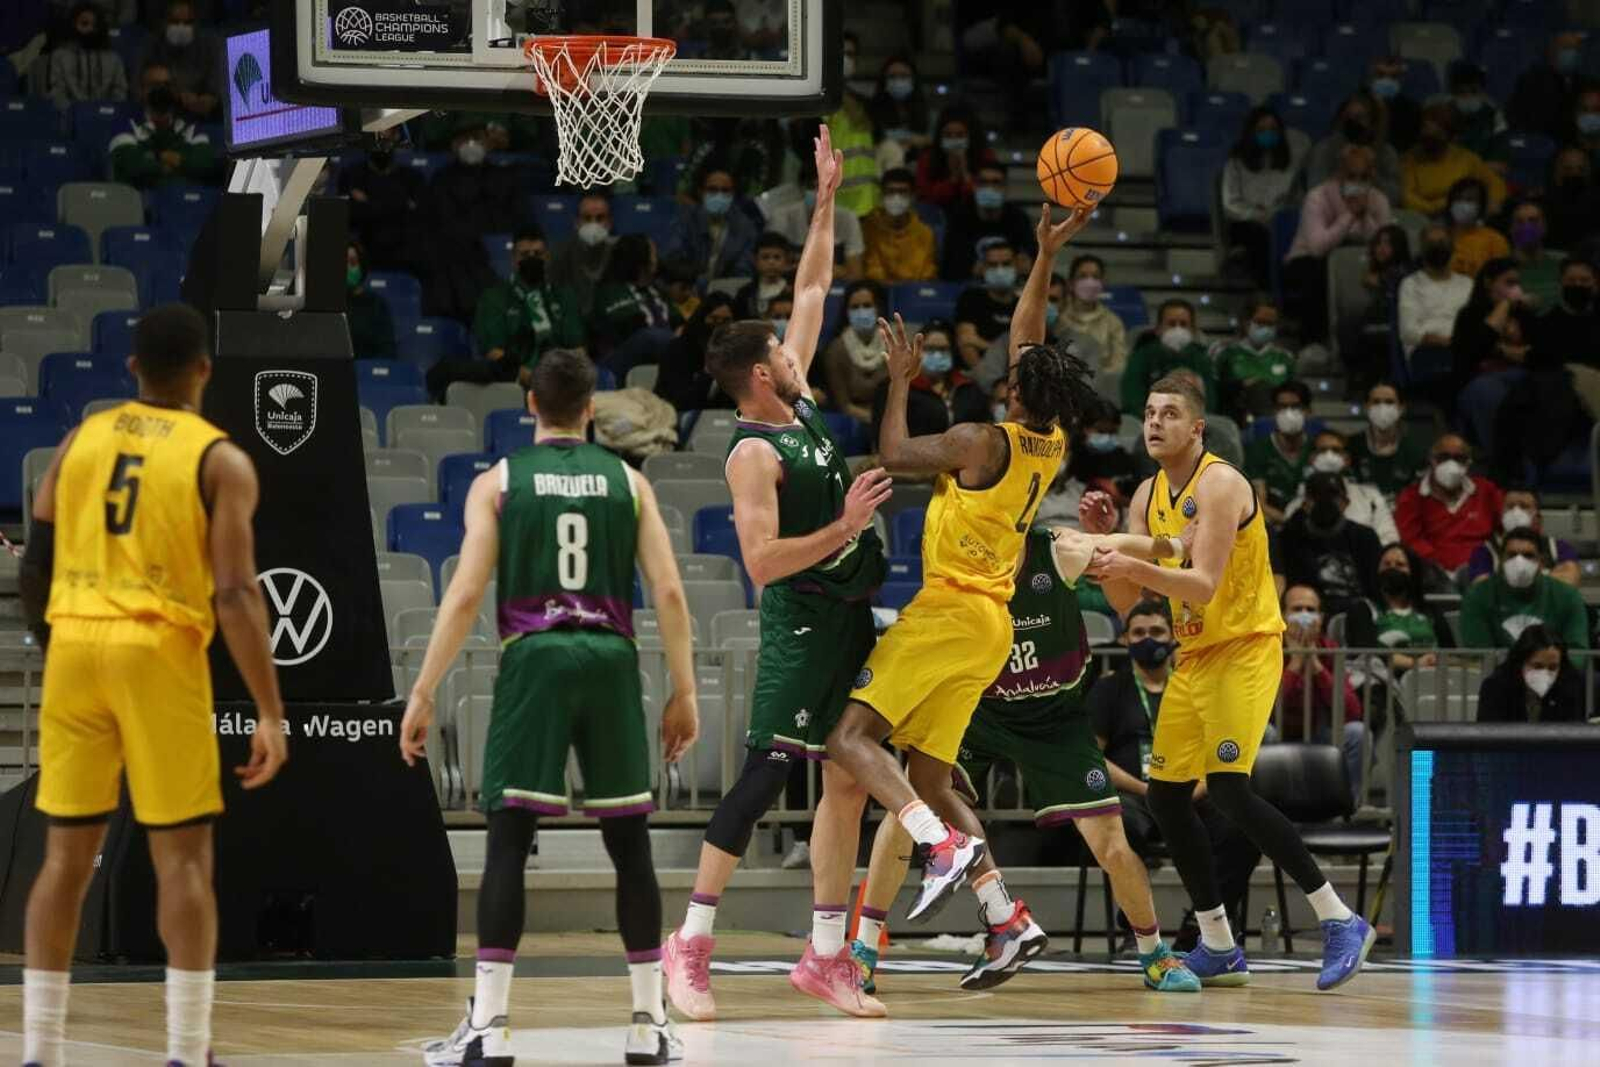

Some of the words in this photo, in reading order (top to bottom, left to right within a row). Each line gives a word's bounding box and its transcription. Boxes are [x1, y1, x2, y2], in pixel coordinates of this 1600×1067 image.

[374, 13, 441, 23] BASKETBALL
[374, 22, 449, 34] CHAMPIONS
[374, 33, 415, 42] LEAGUE
[267, 411, 303, 423] Unicaja
[104, 452, 144, 535] 5
[533, 473, 608, 497] BRIZUELA
[556, 512, 588, 590] 8
[1013, 614, 1051, 627] Unicaja
[1009, 640, 1039, 674] 32
[211, 712, 291, 736] álaa
[304, 715, 393, 742] Wagen
